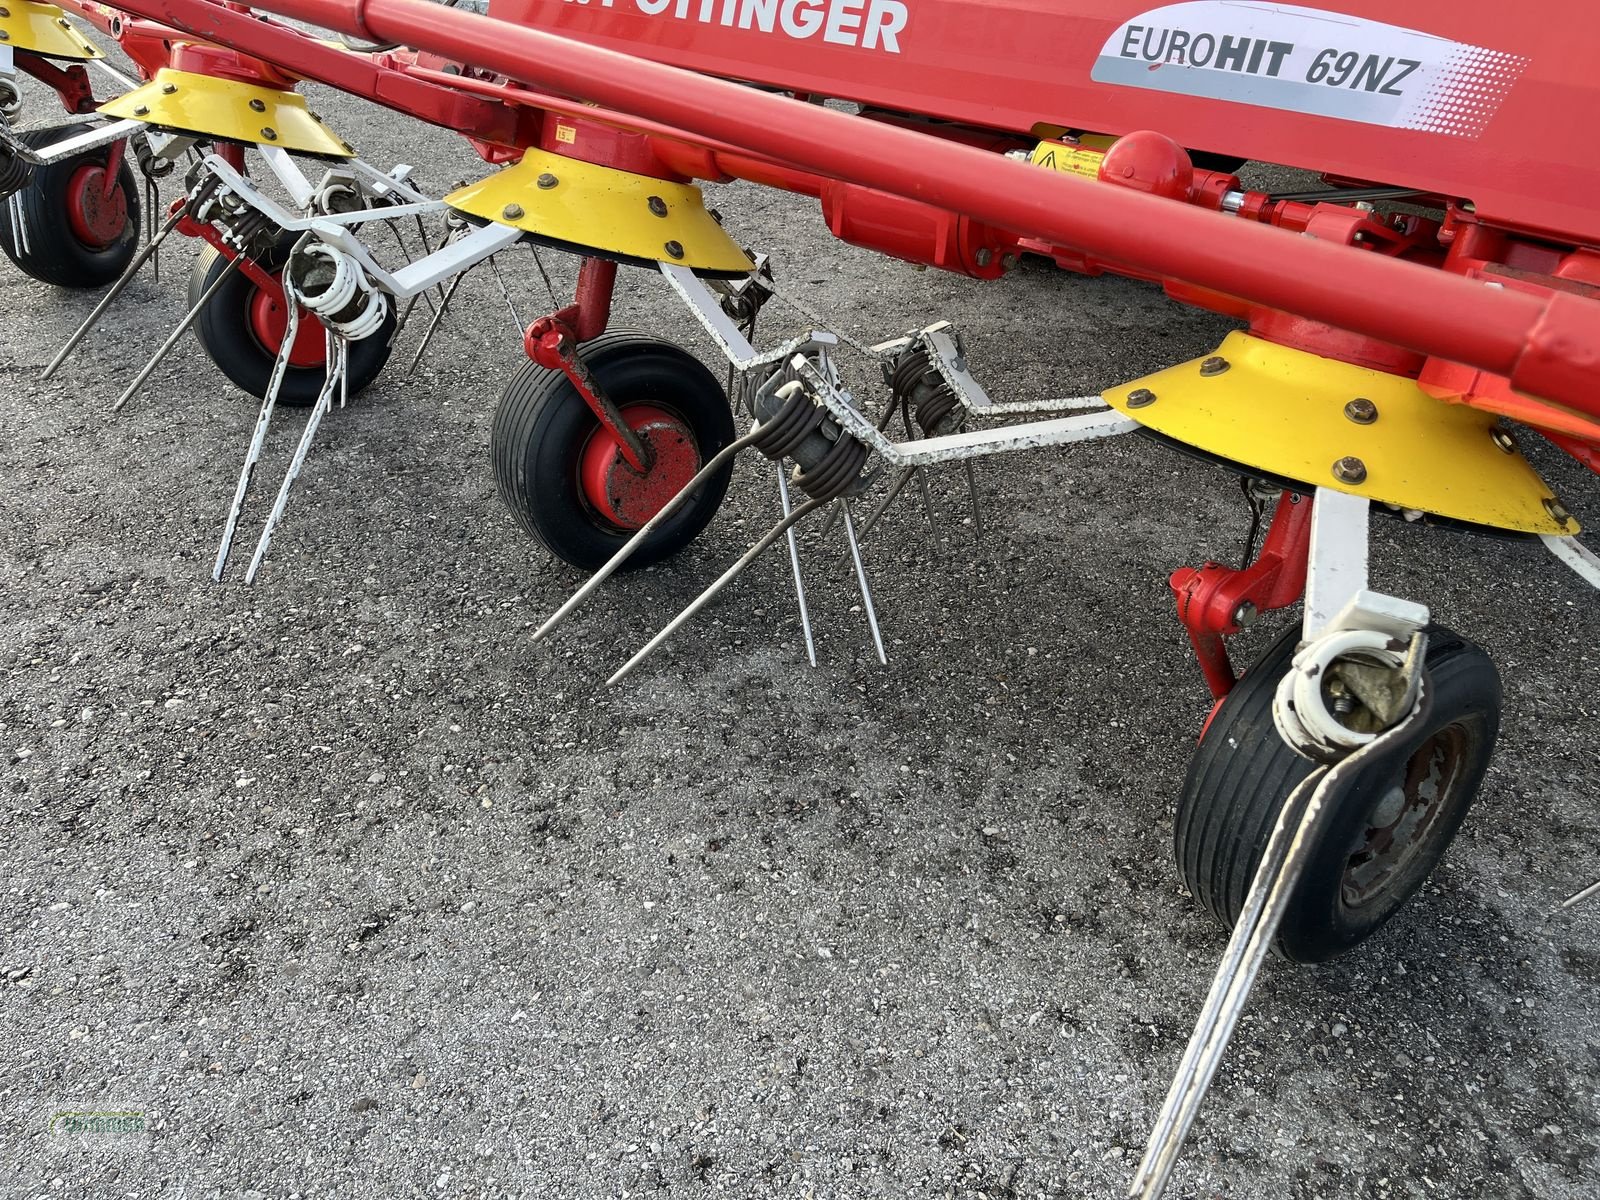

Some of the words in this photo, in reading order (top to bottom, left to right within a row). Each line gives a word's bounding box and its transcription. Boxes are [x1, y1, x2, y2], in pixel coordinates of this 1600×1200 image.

[602, 0, 908, 53] INGER
[1120, 25, 1294, 77] EUROHIT
[1306, 48, 1421, 96] 69NZ
